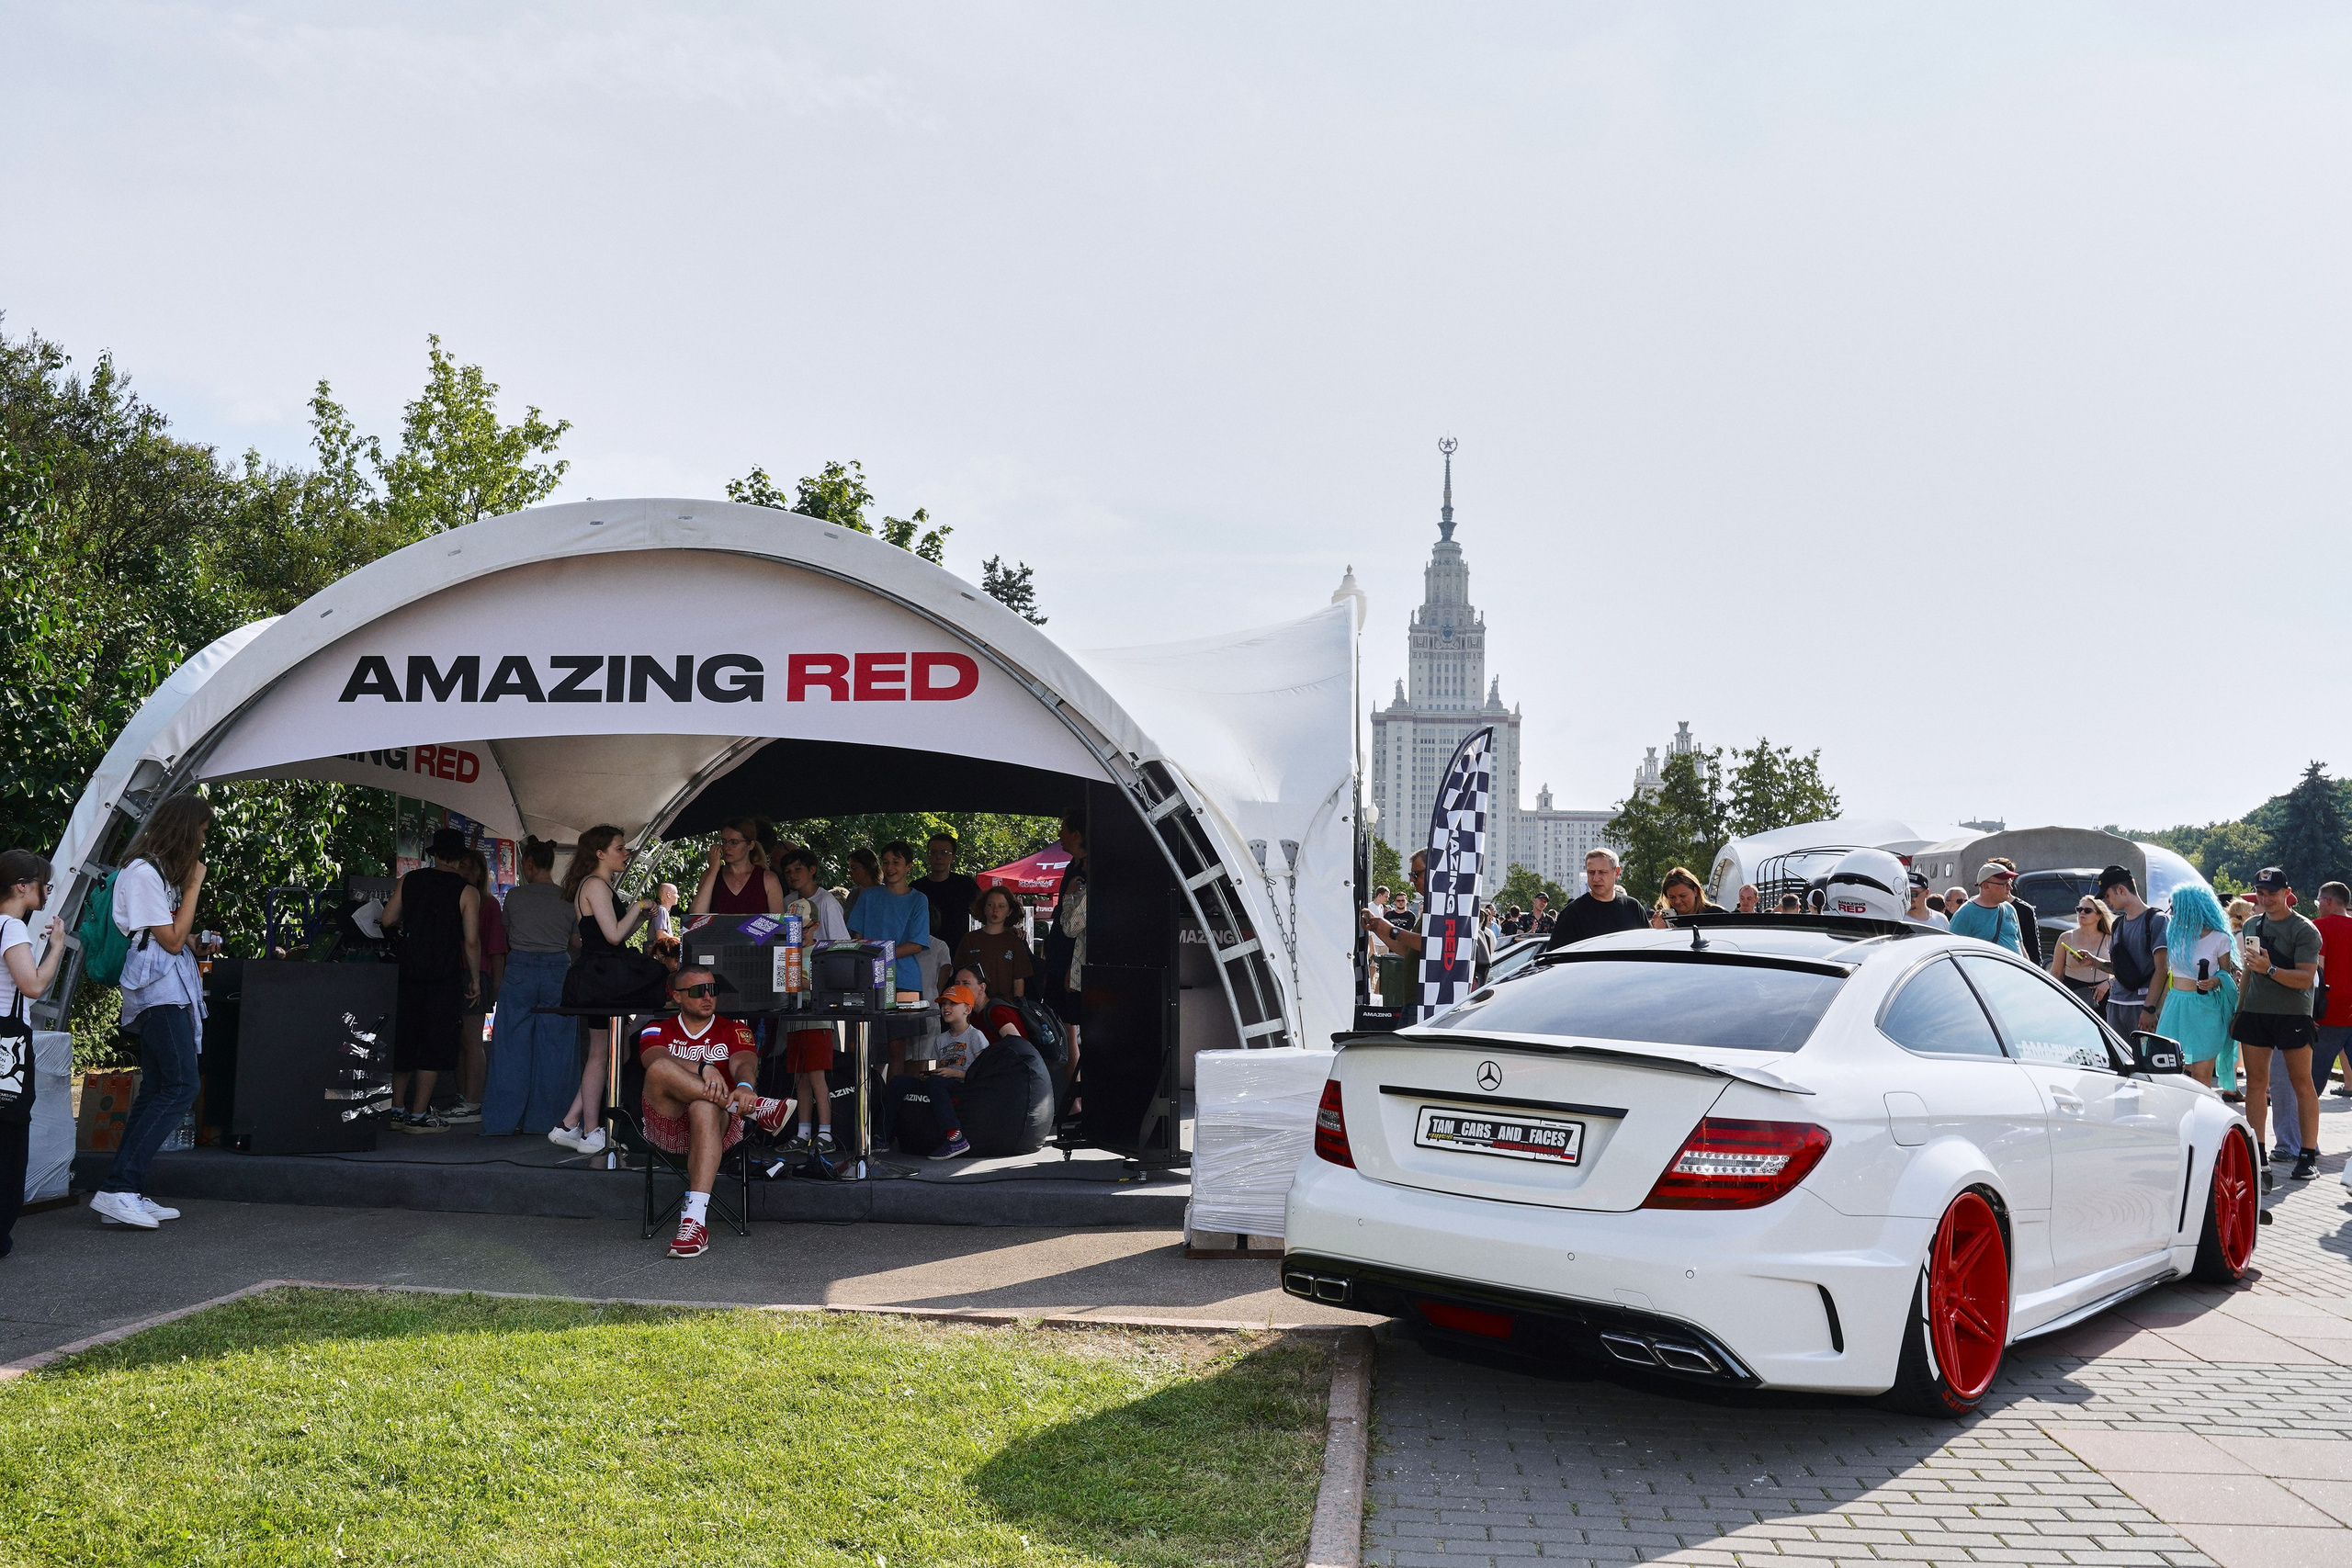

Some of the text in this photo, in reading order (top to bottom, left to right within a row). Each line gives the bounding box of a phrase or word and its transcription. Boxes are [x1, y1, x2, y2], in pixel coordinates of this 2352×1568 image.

[338, 652, 979, 703] AMAZING RED
[414, 745, 481, 784] RED
[1838, 904, 1866, 913] RED
[1443, 919, 1456, 971] RED
